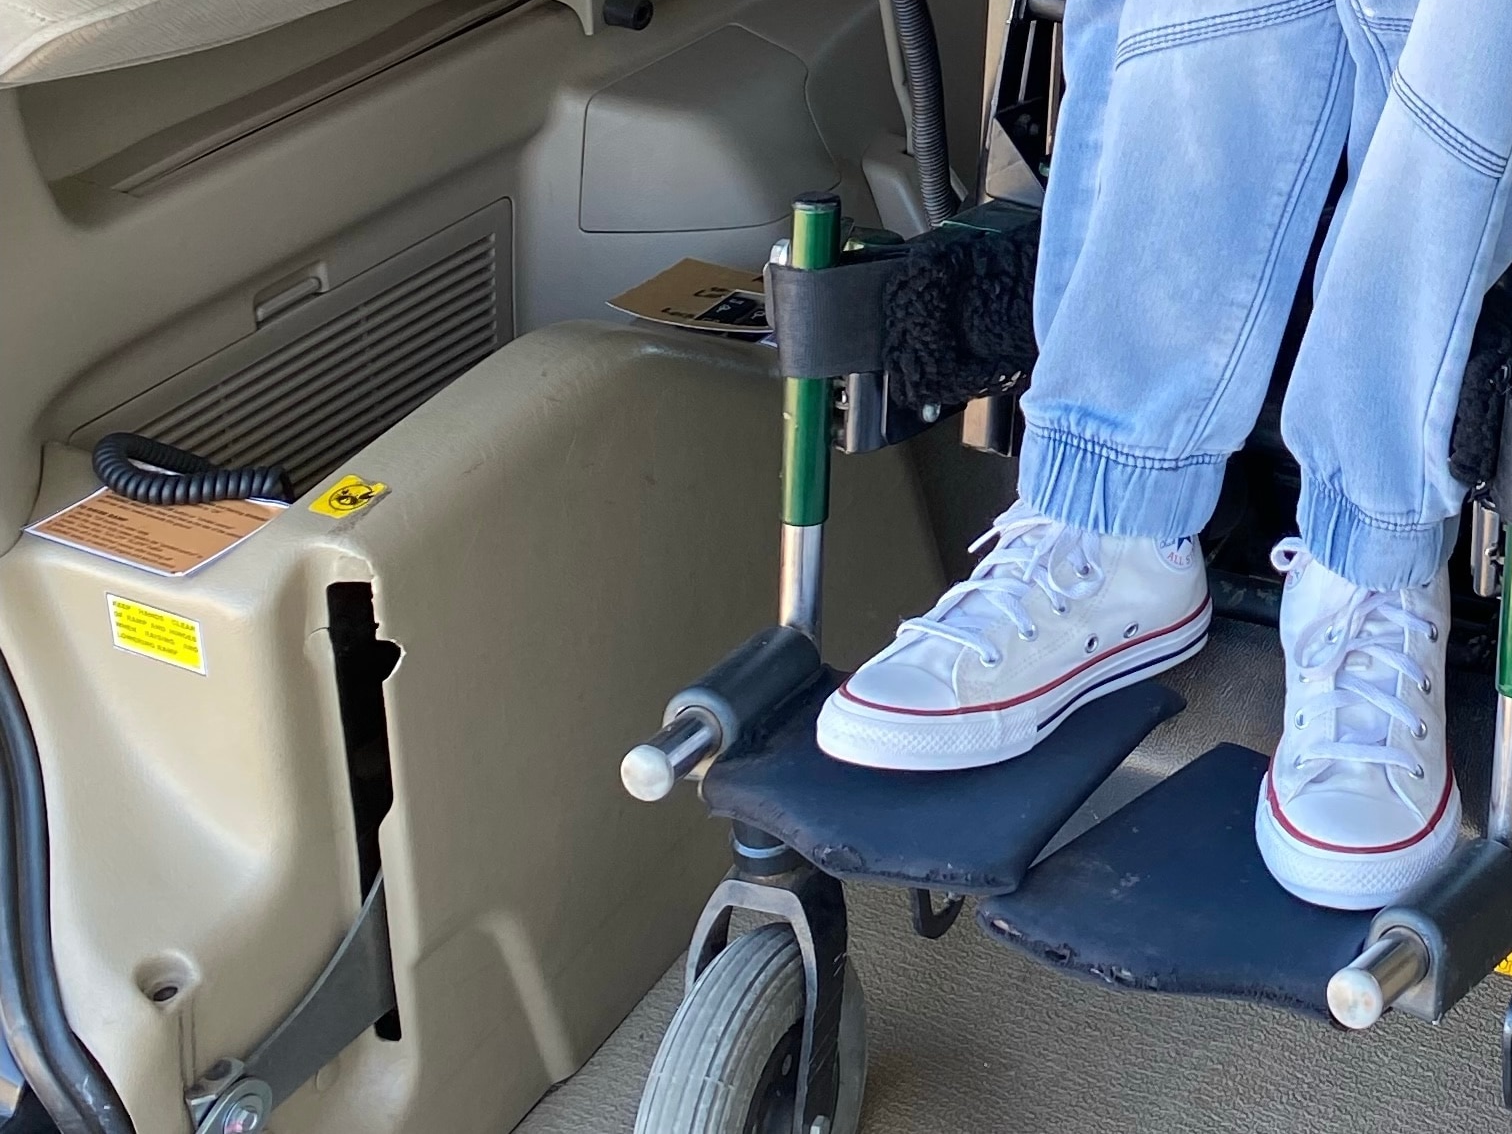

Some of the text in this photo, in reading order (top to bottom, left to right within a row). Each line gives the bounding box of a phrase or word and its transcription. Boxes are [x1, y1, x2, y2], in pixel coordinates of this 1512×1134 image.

[1167, 551, 1184, 565] ALL
[126, 614, 147, 626] RAMP
[137, 608, 163, 621] HANDS
[170, 619, 195, 632] CLEAR
